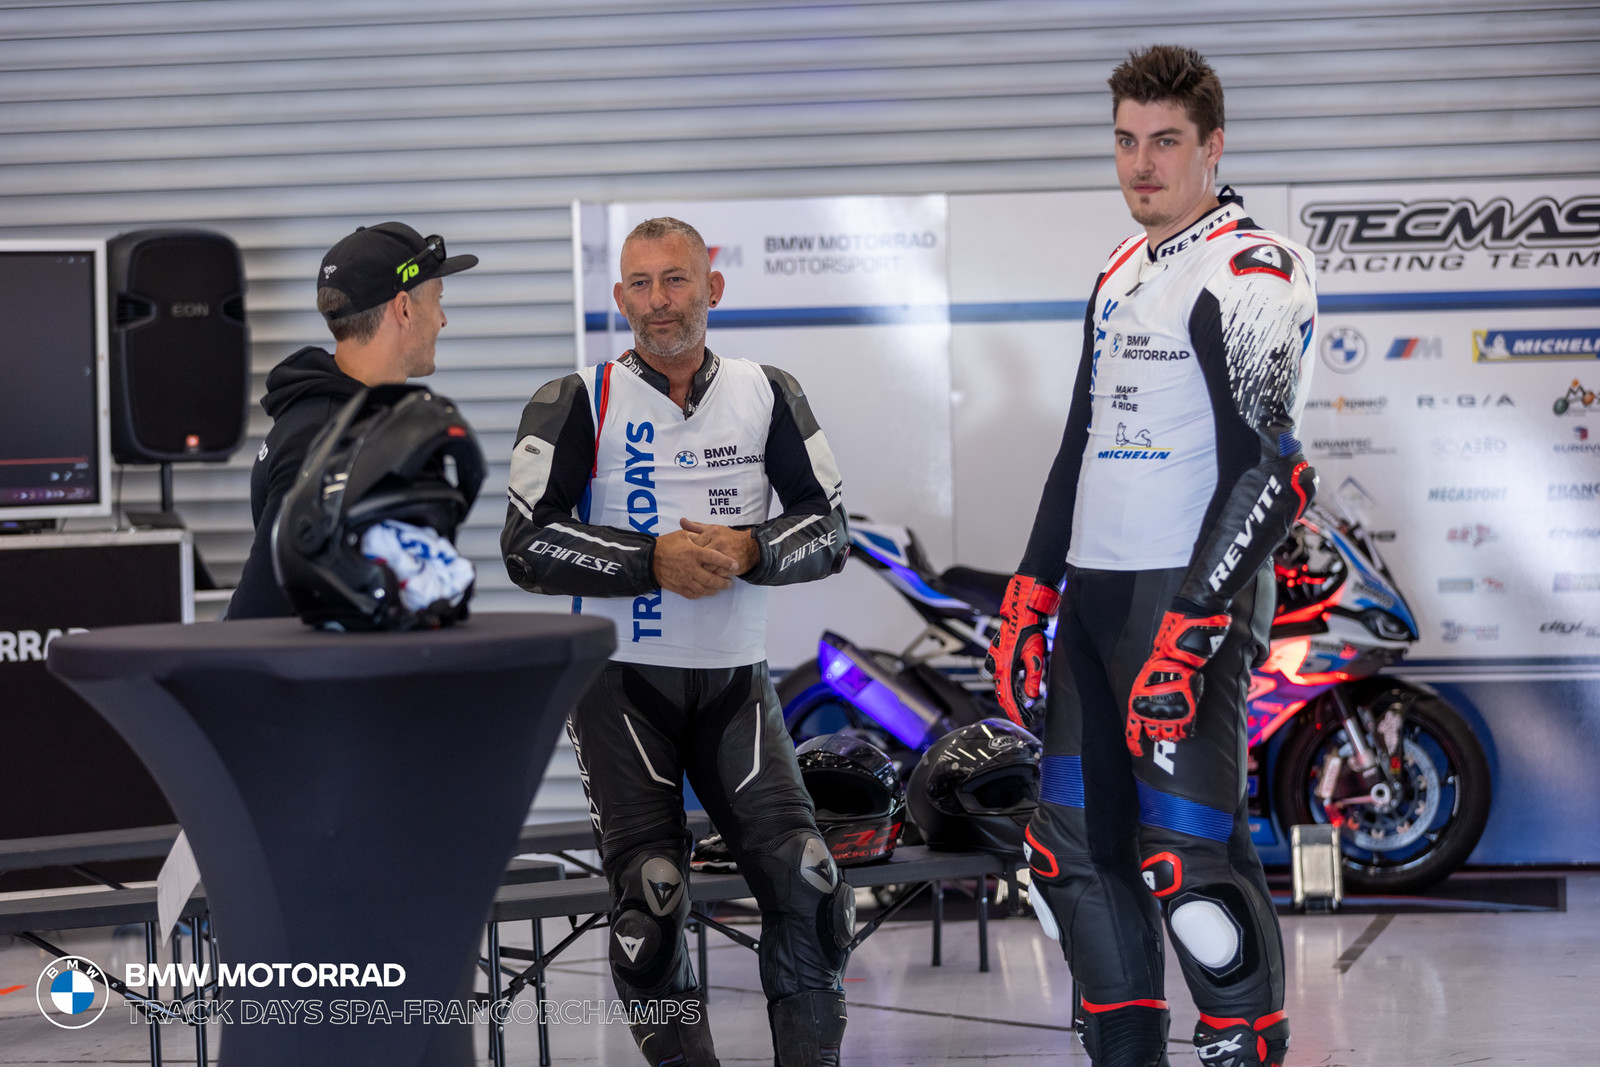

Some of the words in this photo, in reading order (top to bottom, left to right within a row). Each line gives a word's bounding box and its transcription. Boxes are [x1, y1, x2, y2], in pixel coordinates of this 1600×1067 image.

[1301, 196, 1600, 254] TECMAS
[764, 235, 815, 252] BMW
[820, 231, 938, 249] MOTORRAD
[764, 255, 902, 276] MOTORSPORT
[1488, 250, 1600, 269] TEAM
[1126, 336, 1151, 347] BMW
[1122, 349, 1191, 361] MOTORRAD
[1115, 385, 1139, 394] MAKE
[1111, 401, 1118, 410] A
[1119, 403, 1138, 412] RIDE
[704, 445, 737, 459] BMW
[1098, 450, 1171, 461] MICHELIN
[709, 498, 730, 506] LIFE
[710, 508, 718, 516] A
[719, 507, 742, 515] RIDE
[1208, 475, 1282, 592] REV'IT!
[528, 540, 622, 575] DAINESE
[779, 529, 837, 573] DAINESE
